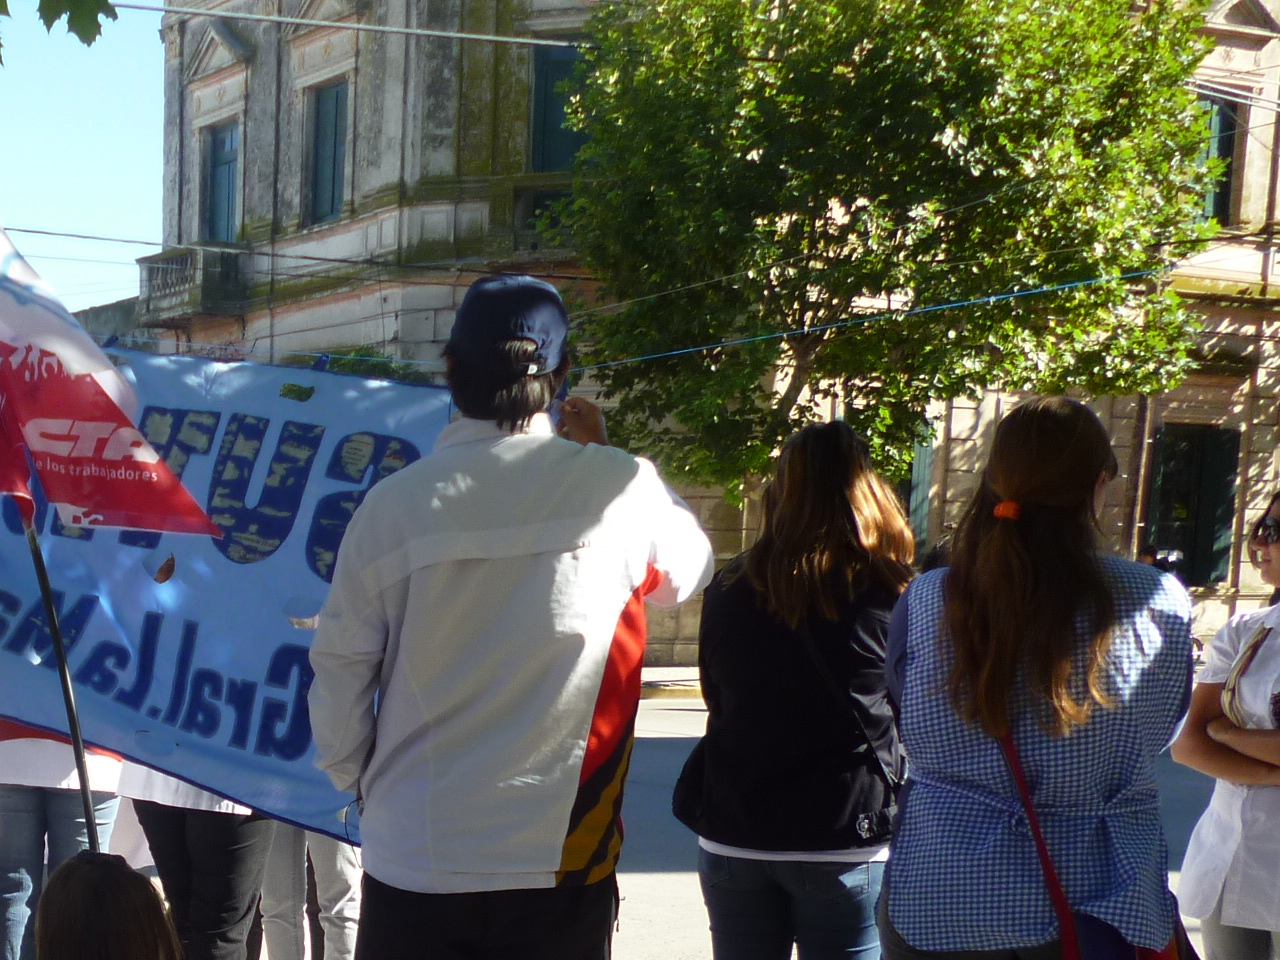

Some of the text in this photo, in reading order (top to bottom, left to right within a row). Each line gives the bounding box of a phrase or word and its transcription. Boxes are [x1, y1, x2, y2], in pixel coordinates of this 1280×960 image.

[21, 418, 160, 464] CTA
[47, 457, 66, 474] los
[69, 464, 158, 482] trabajadores
